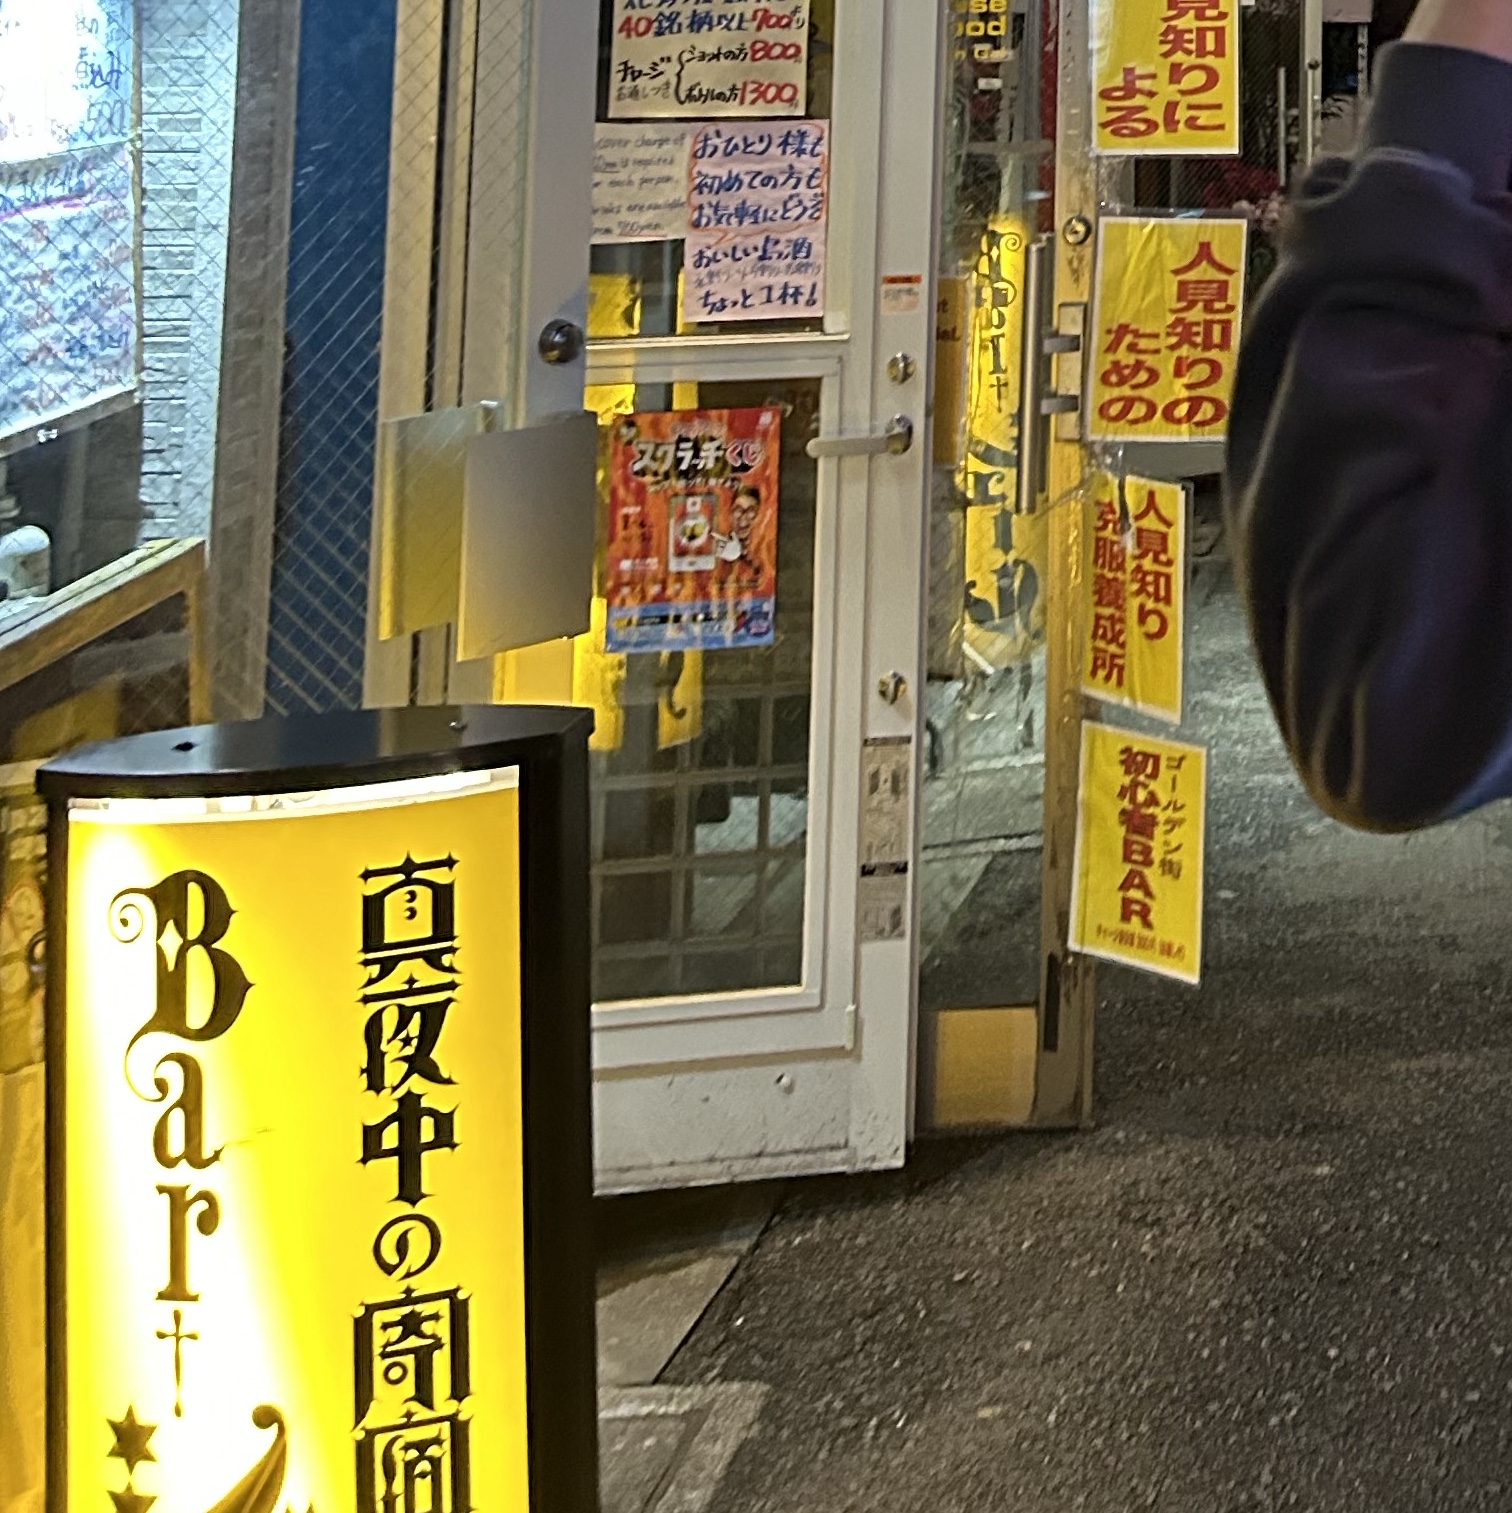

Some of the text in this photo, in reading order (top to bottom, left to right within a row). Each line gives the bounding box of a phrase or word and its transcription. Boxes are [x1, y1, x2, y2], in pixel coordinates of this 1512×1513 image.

[693, 129, 825, 159] おひとり様も
[1098, 66, 1158, 138] よる
[1098, 322, 1161, 425] ための
[1162, 241, 1238, 427] 人見知りの
[1130, 489, 1173, 641] 人見知り
[1117, 745, 1161, 931] 初心者BAR
[1159, 753, 1187, 881] ゴールデン街
[109, 870, 255, 1302] Bar
